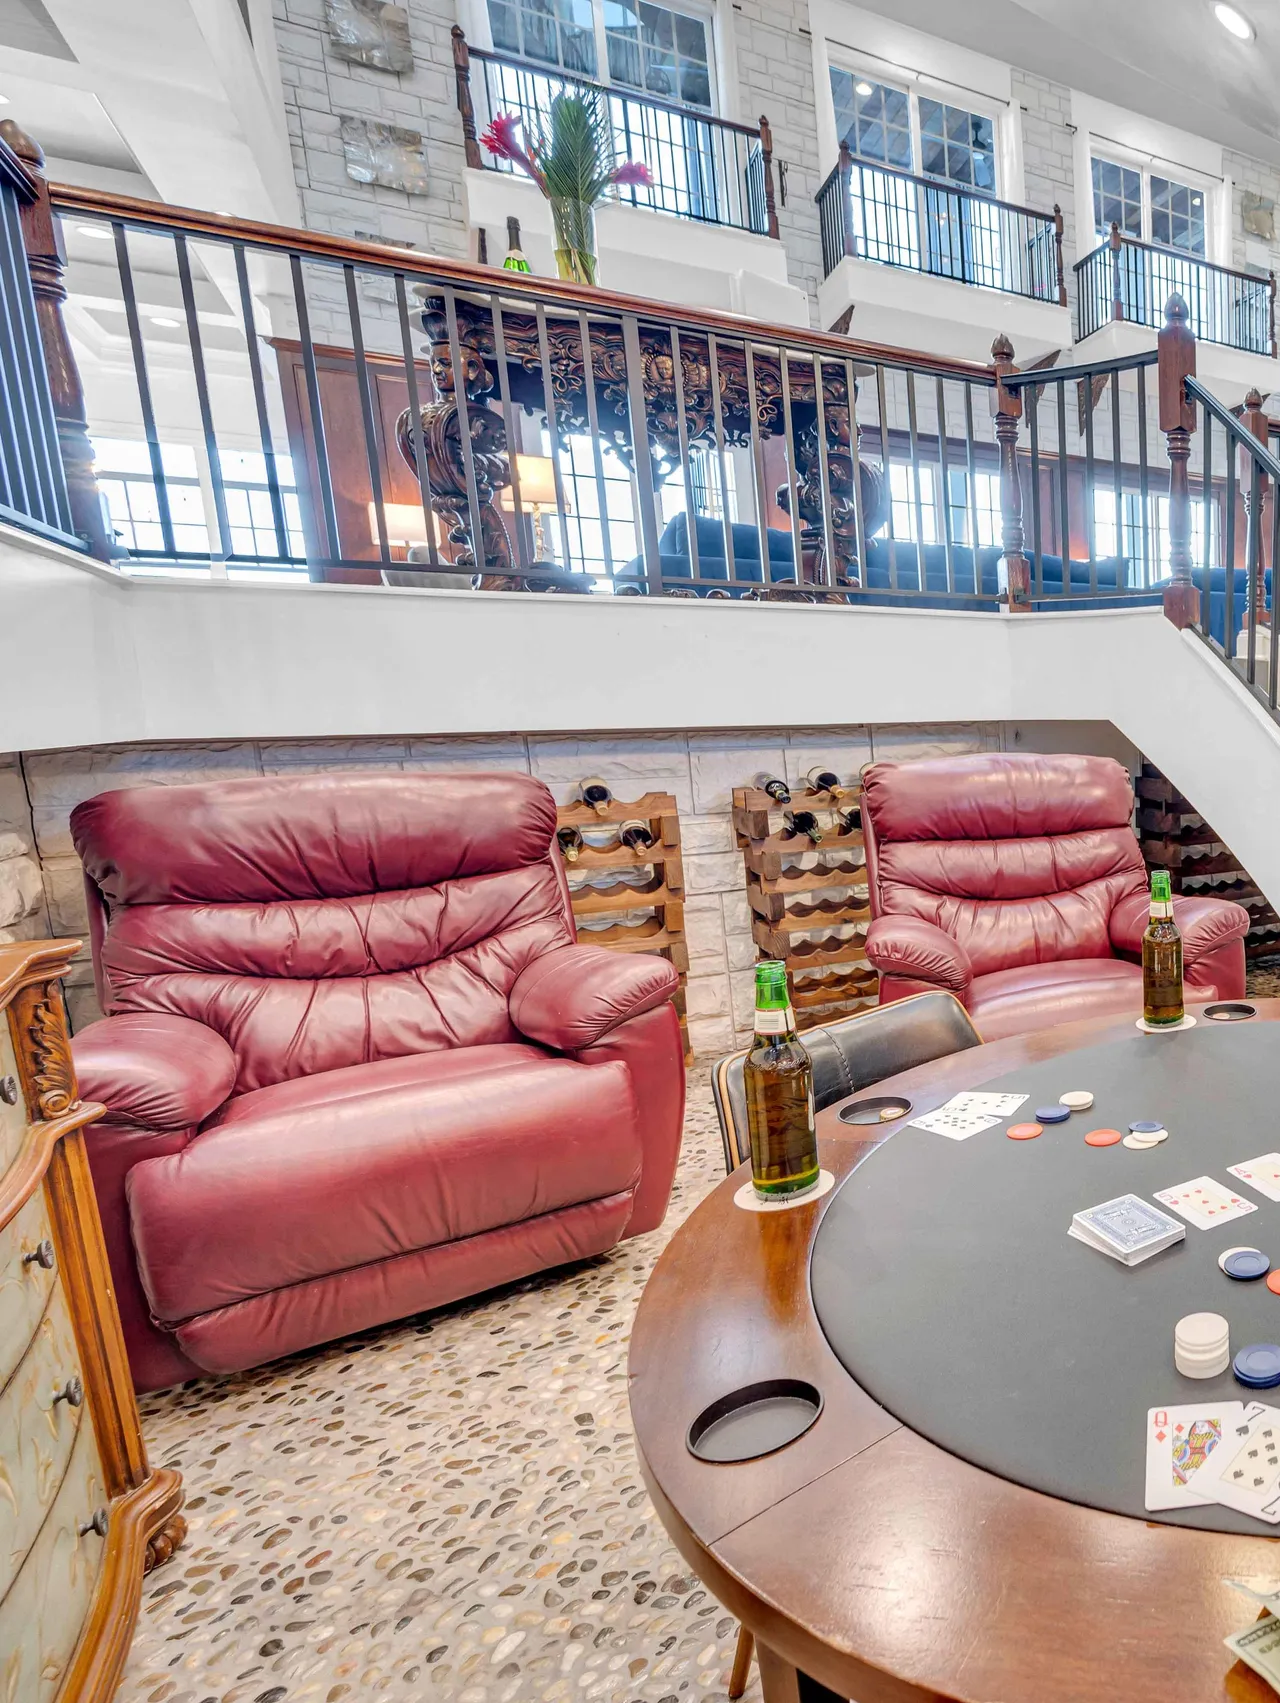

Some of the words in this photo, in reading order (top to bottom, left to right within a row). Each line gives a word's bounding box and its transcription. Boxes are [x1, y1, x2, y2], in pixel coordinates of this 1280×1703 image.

[1233, 1167, 1246, 1176] A
[1158, 1192, 1174, 1202] 5
[1237, 1202, 1253, 1212] 5
[1247, 1405, 1266, 1422] 7
[1153, 1411, 1168, 1428] Q
